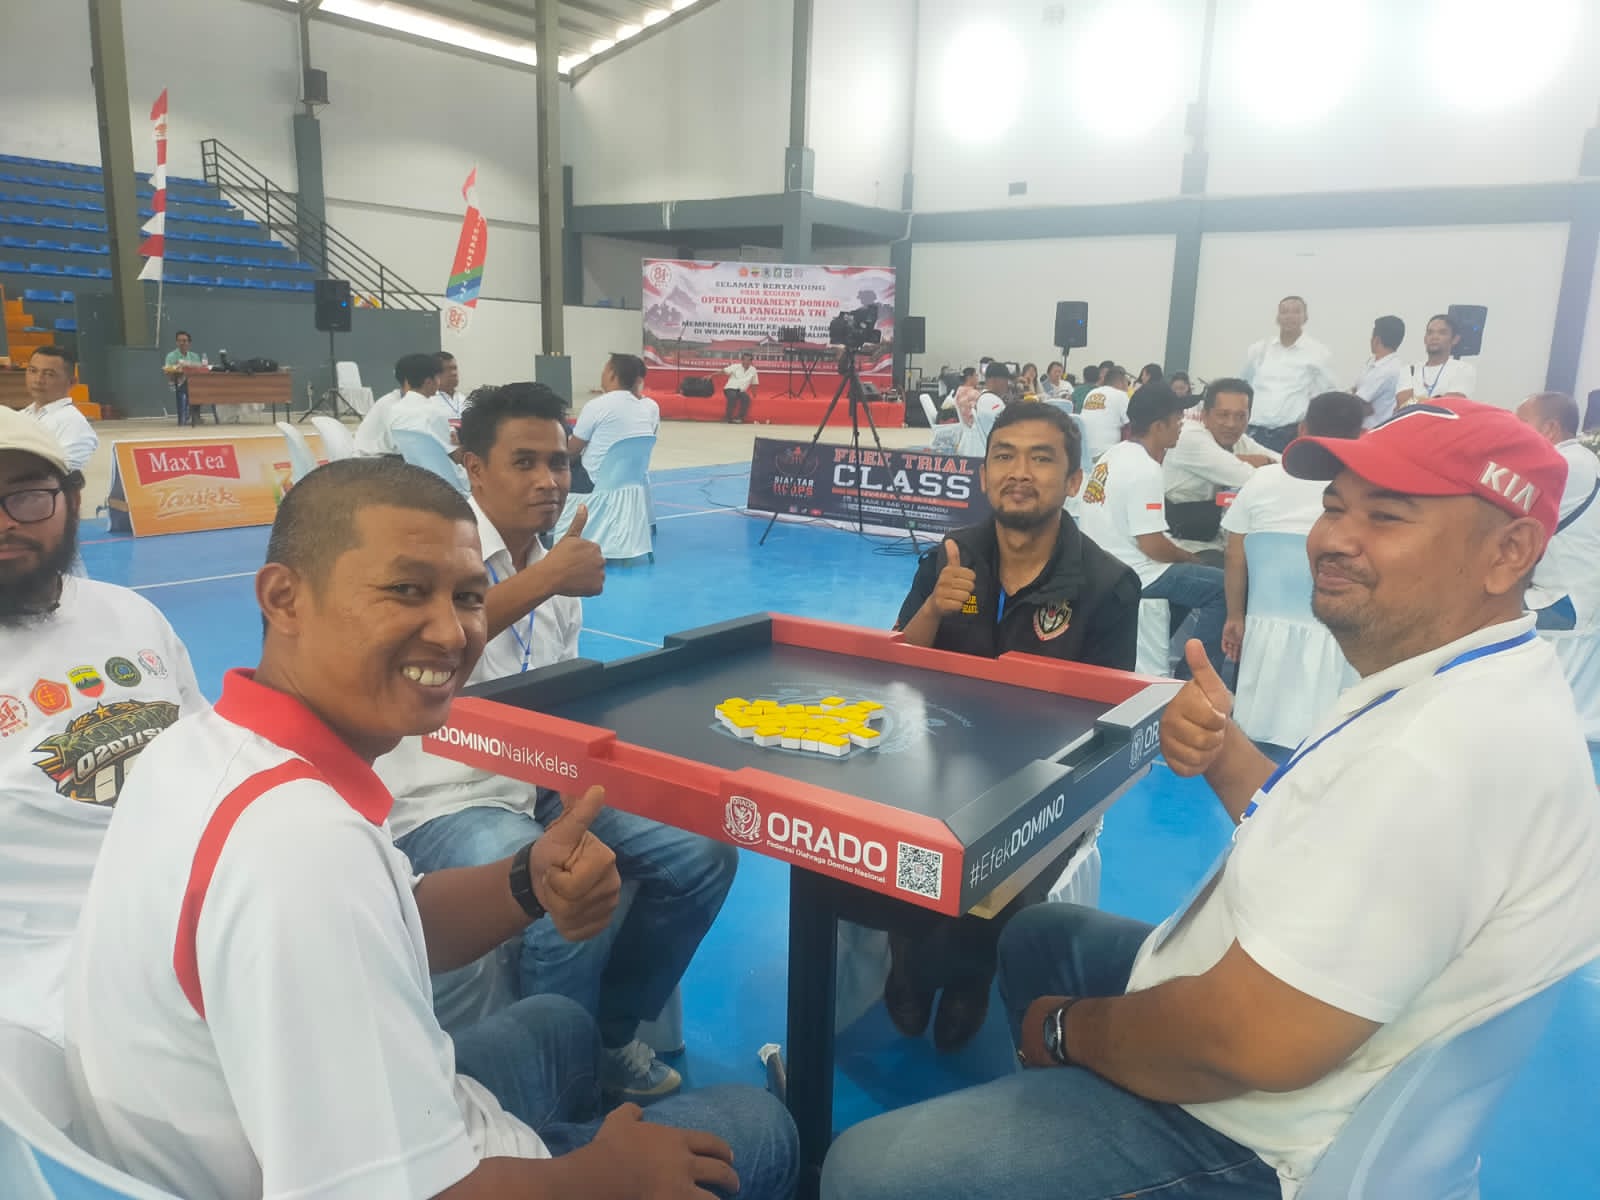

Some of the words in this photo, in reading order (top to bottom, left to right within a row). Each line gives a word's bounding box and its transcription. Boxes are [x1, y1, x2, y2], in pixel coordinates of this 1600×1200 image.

[715, 281, 760, 289] SELAMAT
[763, 282, 826, 291] BERTANDING
[701, 295, 729, 305] OPEN
[730, 297, 797, 307] TOURNAMENT
[799, 299, 840, 308] DOMINO
[713, 305, 747, 314] PIALA
[749, 306, 805, 316] PANGLIMA
[808, 308, 827, 317] TNI
[148, 450, 227, 473] MaxTea
[902, 453, 974, 475] TRIAL
[833, 464, 972, 500] CLASS
[1480, 461, 1537, 513] KIA
[767, 812, 888, 873] ORADO
[969, 793, 1065, 889] #EfekDOMINO
[766, 839, 794, 855] Federasi
[795, 849, 826, 865] Olahraga
[827, 858, 854, 873] Domino
[854, 867, 886, 883] Nasional
